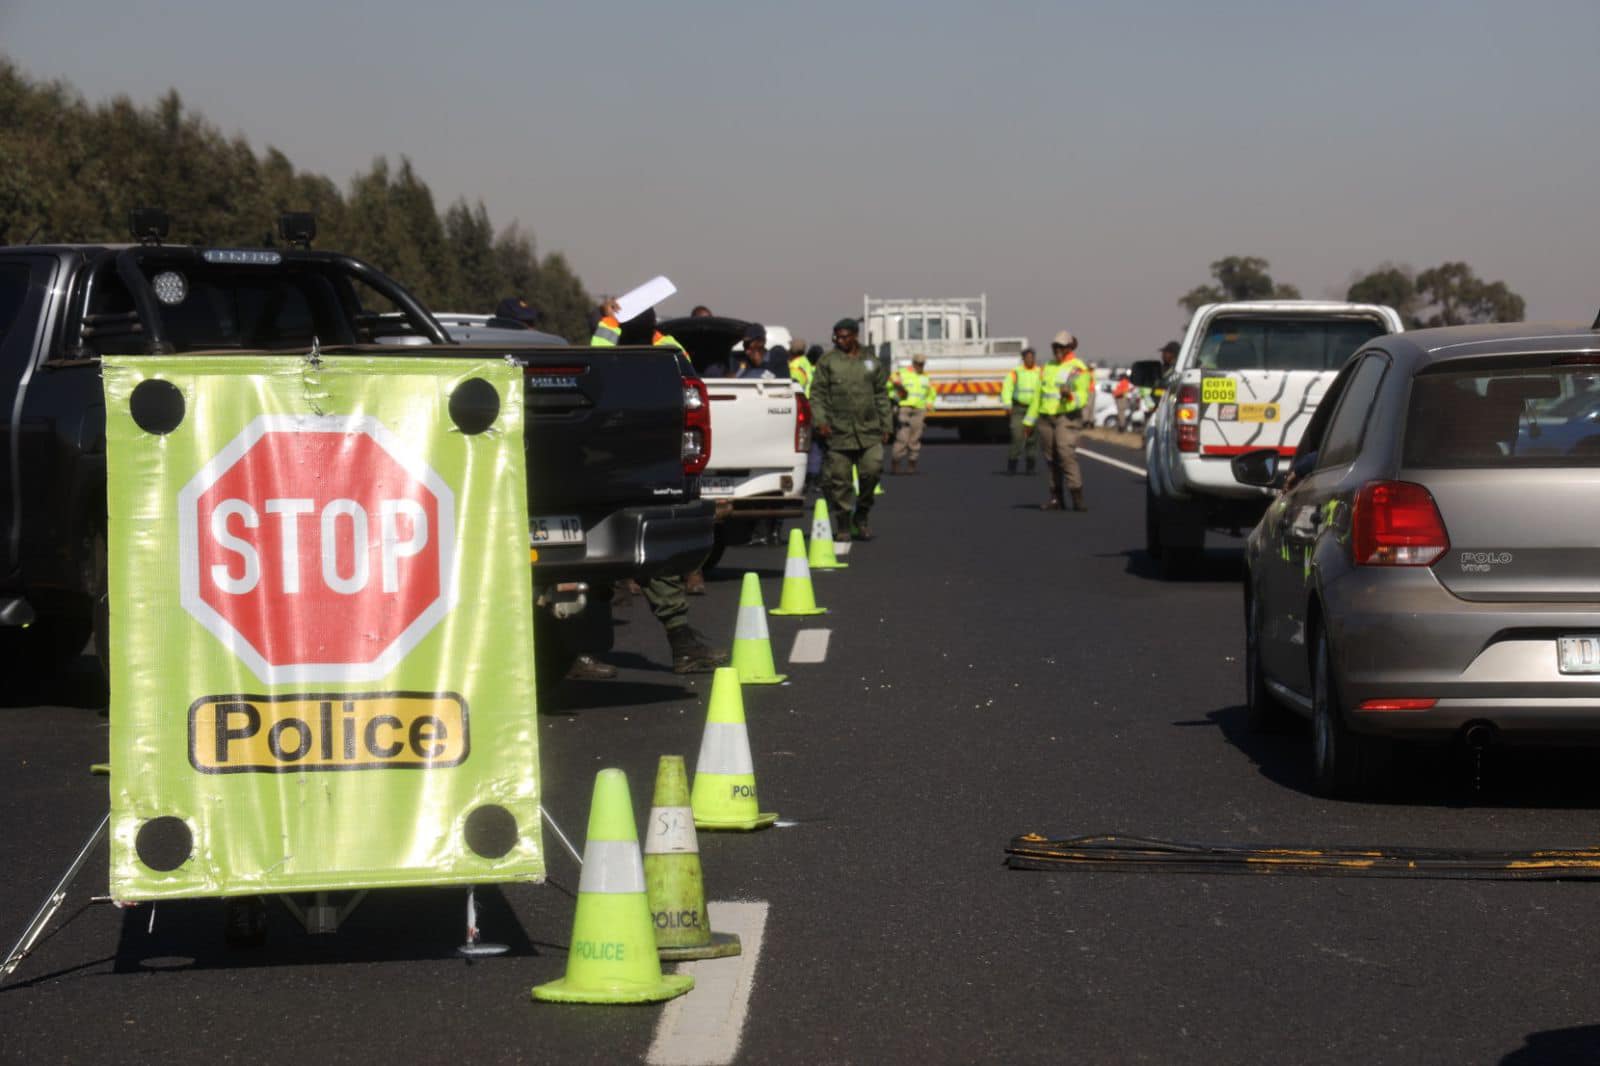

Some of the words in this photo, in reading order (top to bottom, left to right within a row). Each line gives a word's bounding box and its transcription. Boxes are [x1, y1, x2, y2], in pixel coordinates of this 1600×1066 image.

[210, 498, 428, 595] STOP
[1460, 552, 1513, 564] POLO
[214, 701, 448, 763] Police
[575, 941, 625, 961] POLICE
